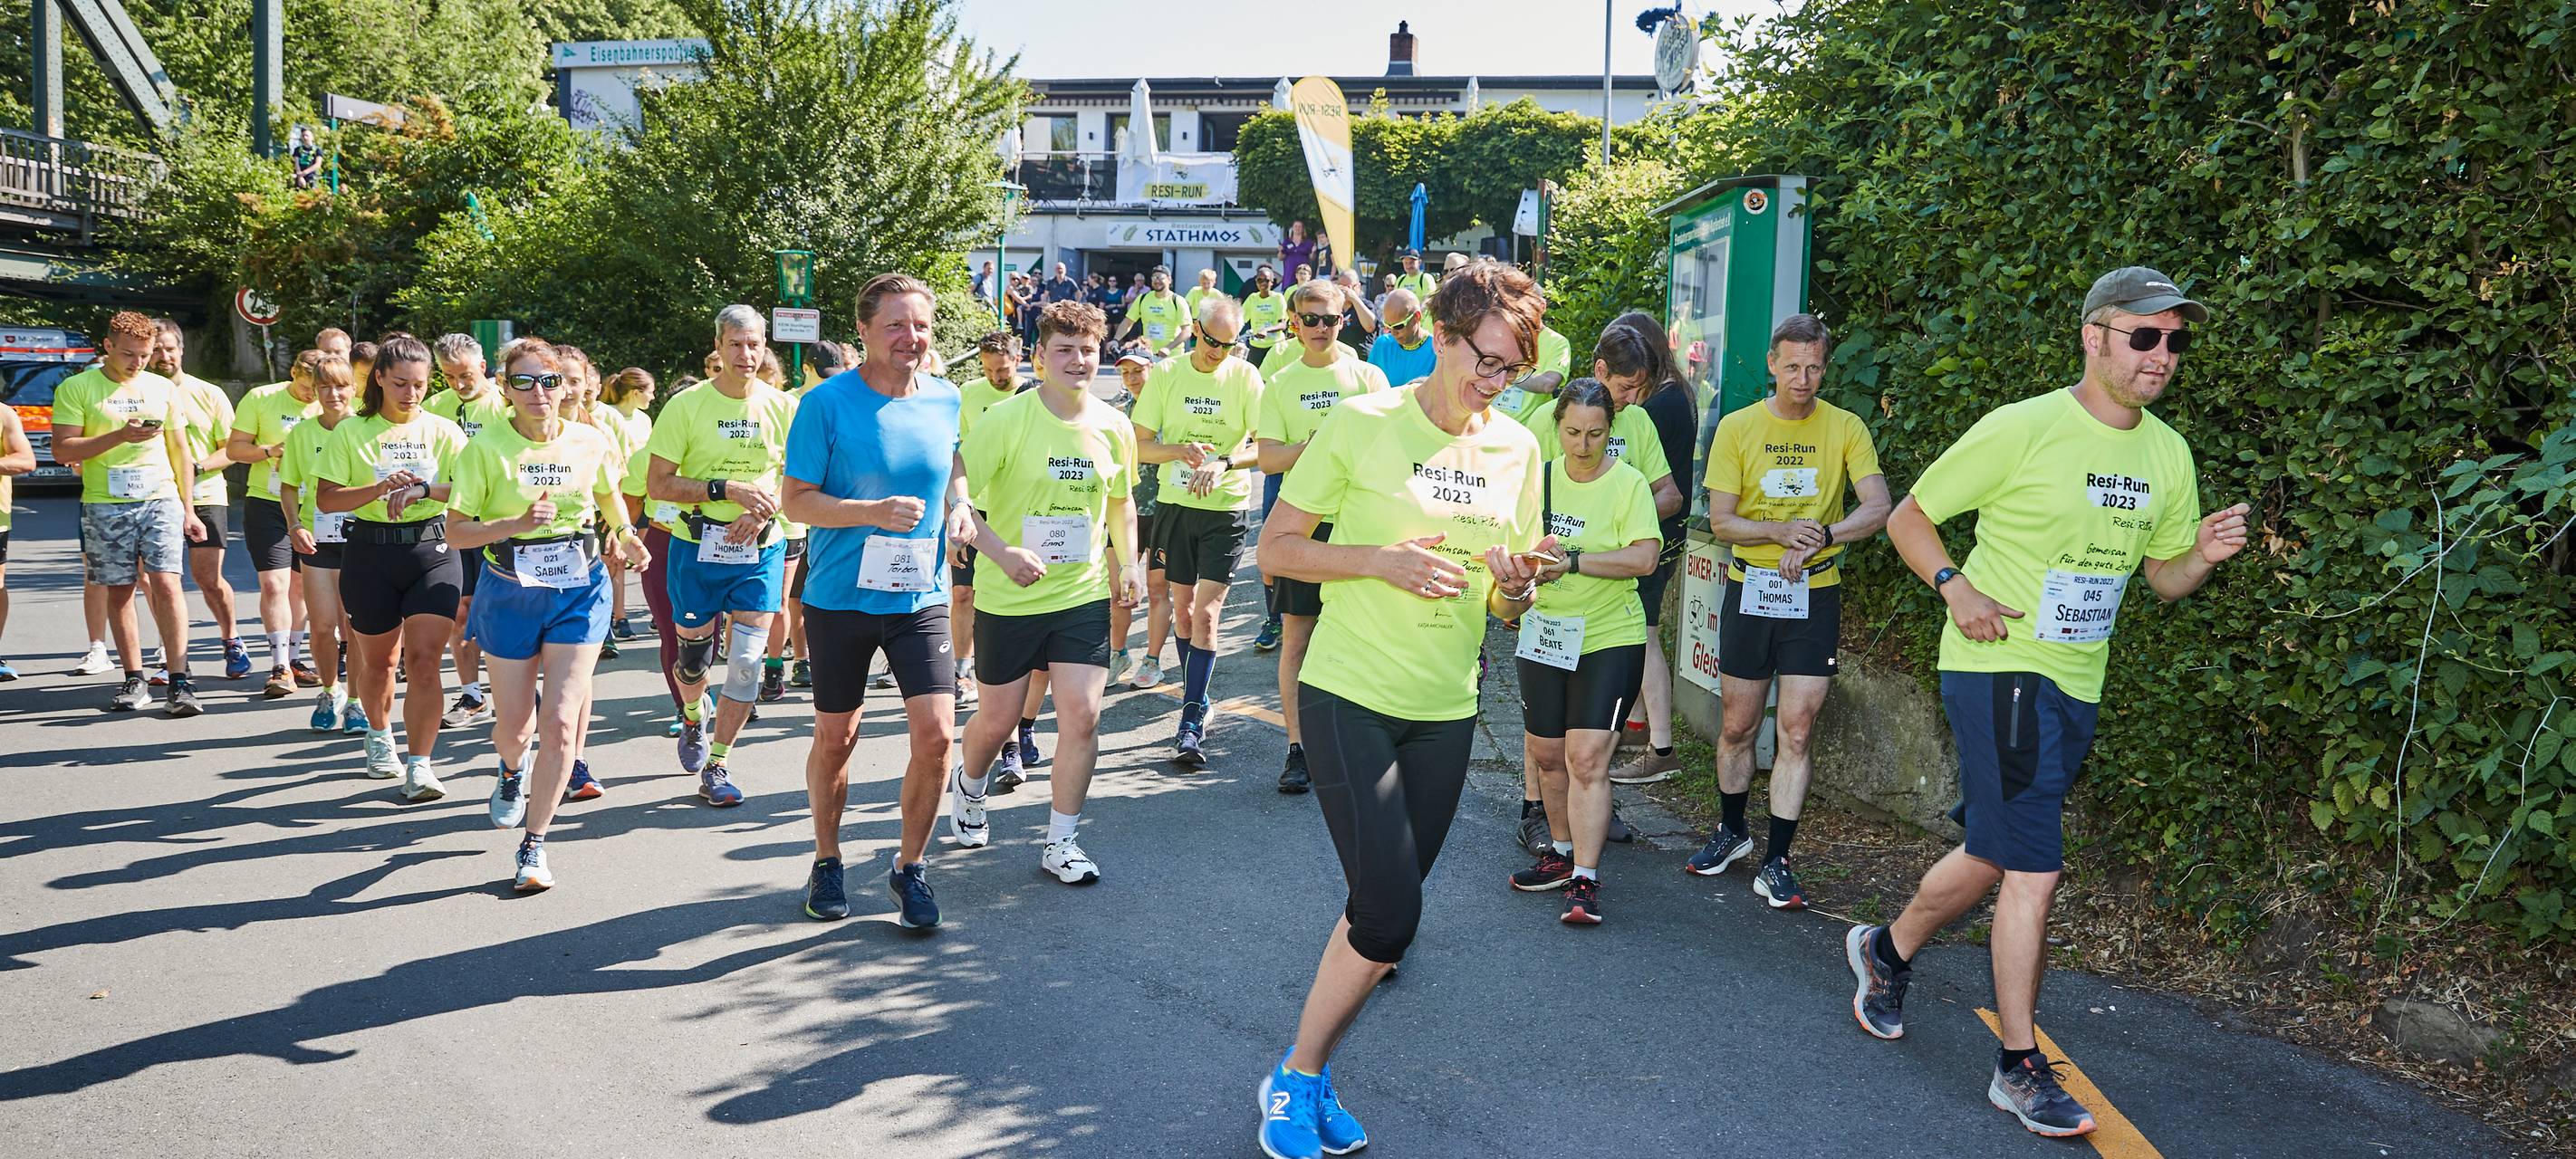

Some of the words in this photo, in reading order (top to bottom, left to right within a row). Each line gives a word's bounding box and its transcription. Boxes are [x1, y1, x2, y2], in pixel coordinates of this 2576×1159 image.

[1151, 185, 1203, 197] RESI-RUN
[1146, 229, 1241, 243] STATHMOS
[1300, 390, 1340, 402] Resi-Run
[1184, 397, 1221, 407] Resi-Run
[1310, 400, 1331, 410] 2023
[1193, 406, 1213, 415] 2023
[717, 419, 760, 428] Resi-Run
[729, 430, 751, 438] 2023
[380, 441, 427, 450] Resi-Run
[1765, 443, 1816, 454] Resi-Run
[393, 451, 418, 460] 2023
[1776, 455, 1804, 465] 2022
[1048, 456, 1094, 468] Resi-Run
[519, 463, 572, 474] Resi-Run
[533, 476, 562, 486] 2023
[1059, 470, 1083, 481] 2023
[1413, 462, 1486, 489] Resi-Run
[2086, 473, 2150, 493] Resi-Run
[1432, 485, 1472, 504] 2023
[2101, 493, 2136, 510] 2023
[2112, 516, 2134, 529] Resi
[1049, 530, 1066, 538] 080
[715, 541, 744, 553] THOMAS
[894, 554, 910, 563] 081
[2078, 559, 2093, 568] den
[534, 564, 569, 577] SABINE
[888, 562, 918, 573] Torben
[1768, 580, 1783, 589] 001
[2074, 576, 2100, 585] RESI-RUN
[2099, 578, 2114, 586] 2023
[1758, 589, 1793, 604] THOMAS
[2083, 589, 2102, 602] 045
[2055, 604, 2113, 623] SEBASTIAN
[1707, 608, 1717, 632] im
[1543, 626, 1555, 637] 061
[1539, 635, 1563, 651] BEATE
[1692, 641, 1719, 679] Gleis
